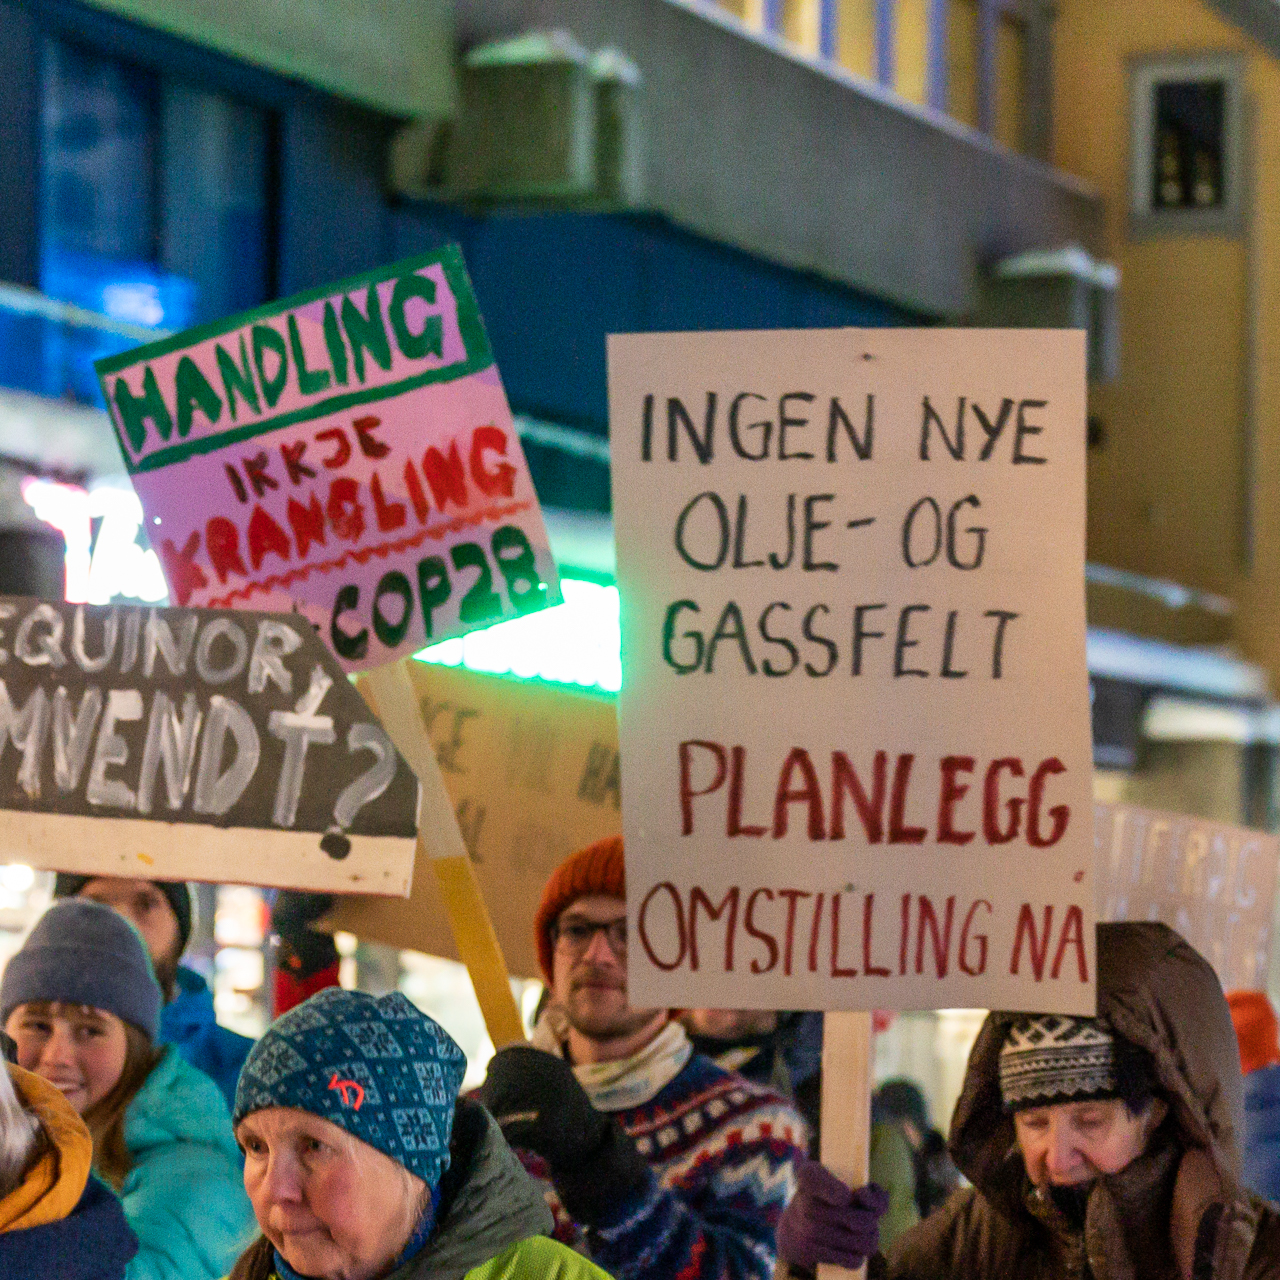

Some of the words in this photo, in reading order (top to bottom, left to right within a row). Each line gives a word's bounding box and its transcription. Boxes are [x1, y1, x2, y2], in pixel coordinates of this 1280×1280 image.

[113, 272, 445, 455] HANDLING
[225, 415, 392, 504] IKKJE
[640, 391, 875, 465] INGEN
[920, 396, 1049, 465] NYE
[163, 425, 518, 607] KRANGLING
[673, 490, 877, 573] OLJE-
[901, 493, 990, 572] OG
[662, 599, 1021, 679] GASSFELT
[678, 738, 1072, 848] PLANLEGG
[637, 880, 993, 977] OMSTILLING
